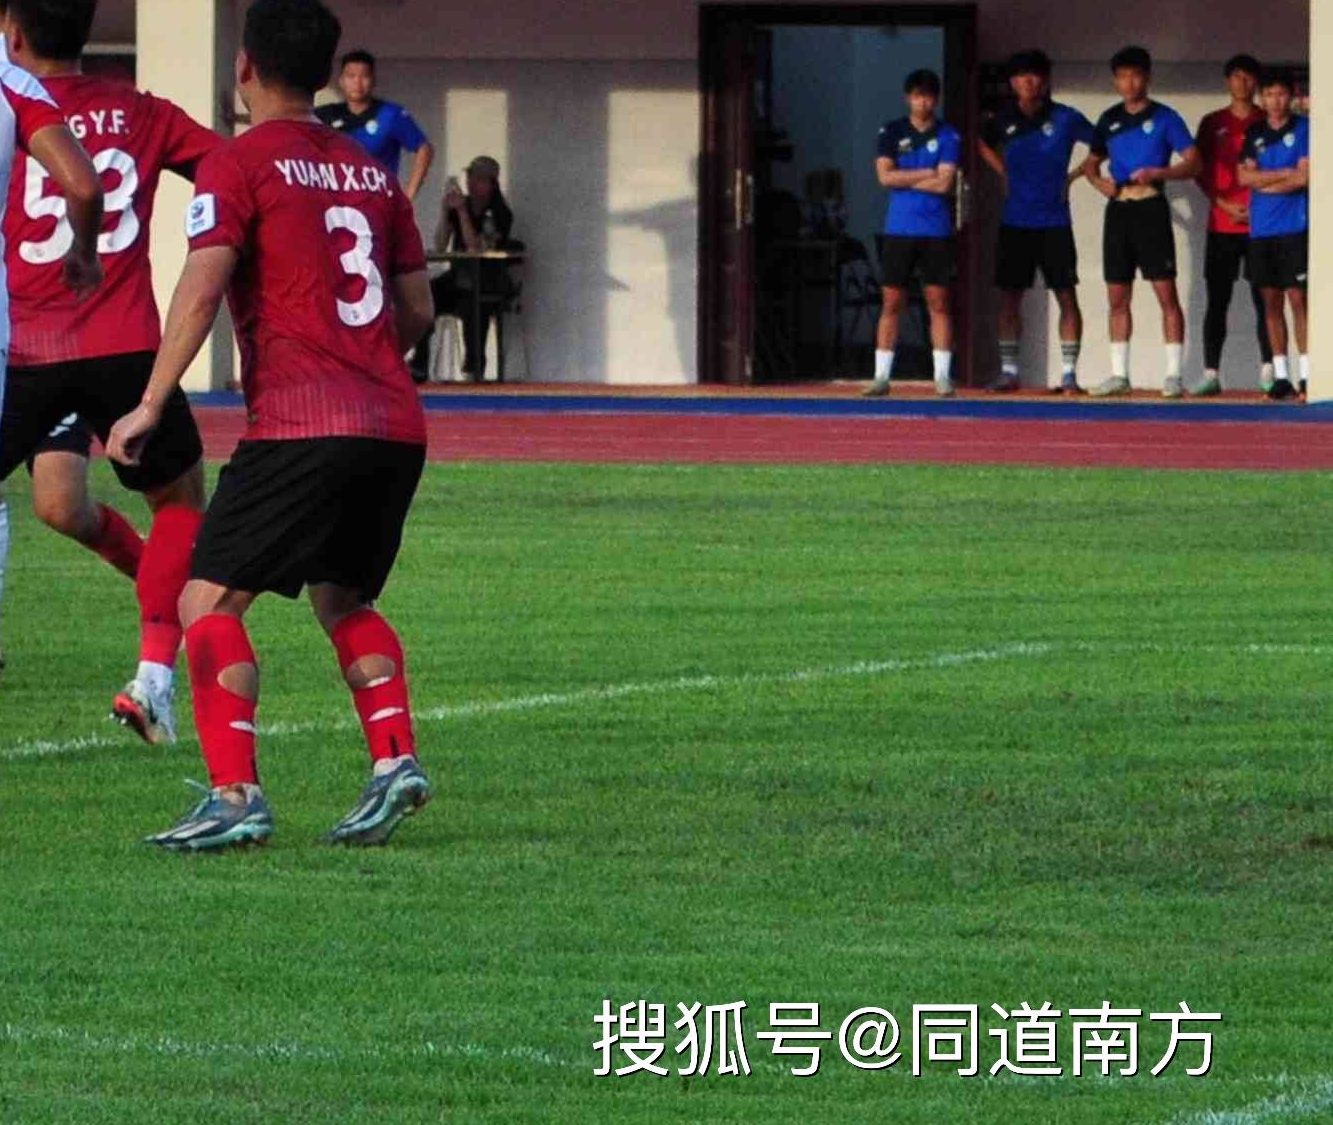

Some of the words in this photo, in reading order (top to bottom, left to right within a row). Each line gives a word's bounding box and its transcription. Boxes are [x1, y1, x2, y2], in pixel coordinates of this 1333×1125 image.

[91, 108, 130, 136] Y.F.
[19, 147, 140, 265] 53
[276, 158, 339, 192] YUAN
[342, 163, 393, 198] X.CH.
[325, 205, 385, 327] 3
